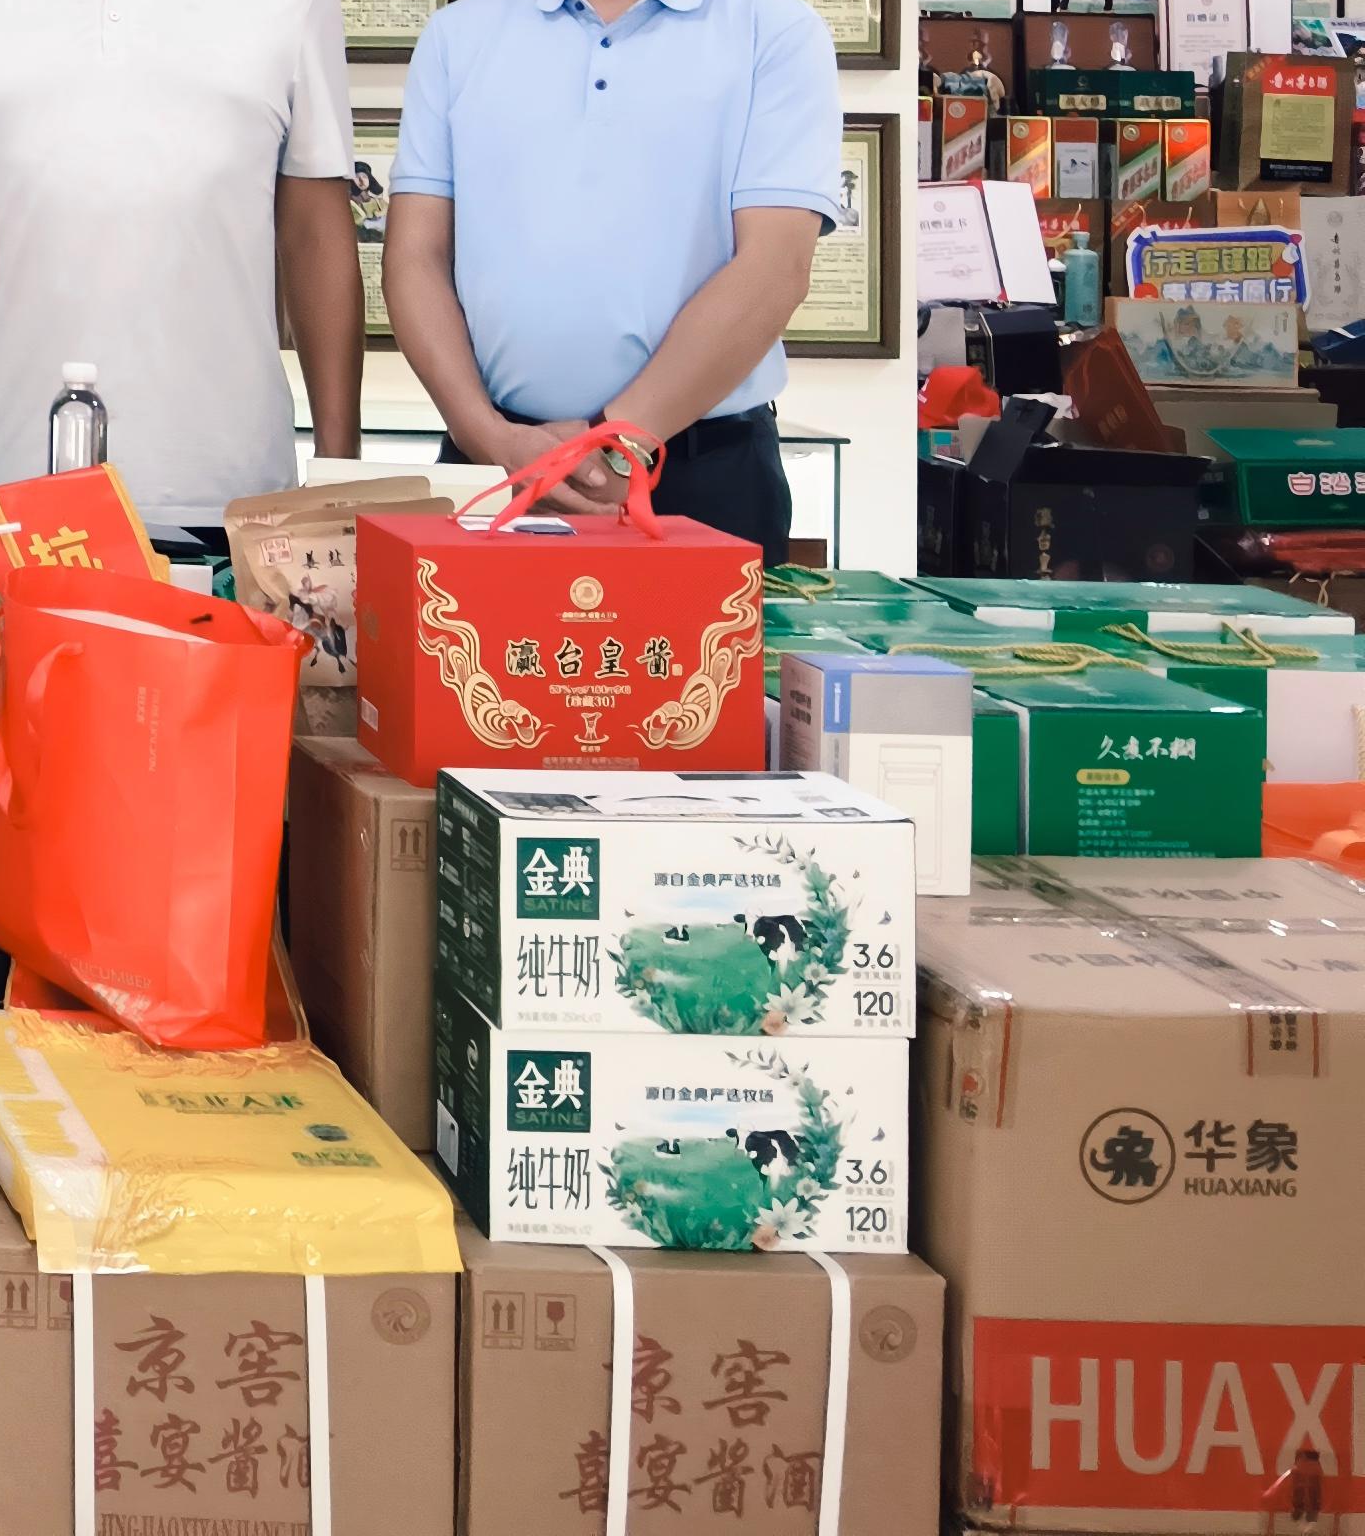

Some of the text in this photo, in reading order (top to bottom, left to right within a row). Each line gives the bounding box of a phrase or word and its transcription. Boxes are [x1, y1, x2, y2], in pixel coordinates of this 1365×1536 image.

[522, 845, 595, 896] 金典
[523, 898, 595, 914] SATINE
[516, 933, 601, 999] 纯牛奶
[852, 990, 894, 1017] 120
[513, 1059, 585, 1110] 金典
[514, 1111, 586, 1127] SATINE
[1183, 1119, 1299, 1173] 华象
[507, 1145, 590, 1210] 纯牛奶
[845, 1159, 888, 1186] 3.6
[1183, 1176, 1298, 1198] HUAXIANG
[845, 1206, 888, 1233] 120
[114, 1314, 305, 1409] 京窖
[602, 1333, 791, 1429] 京窖
[558, 1430, 823, 1519] 喜宴酱酒
